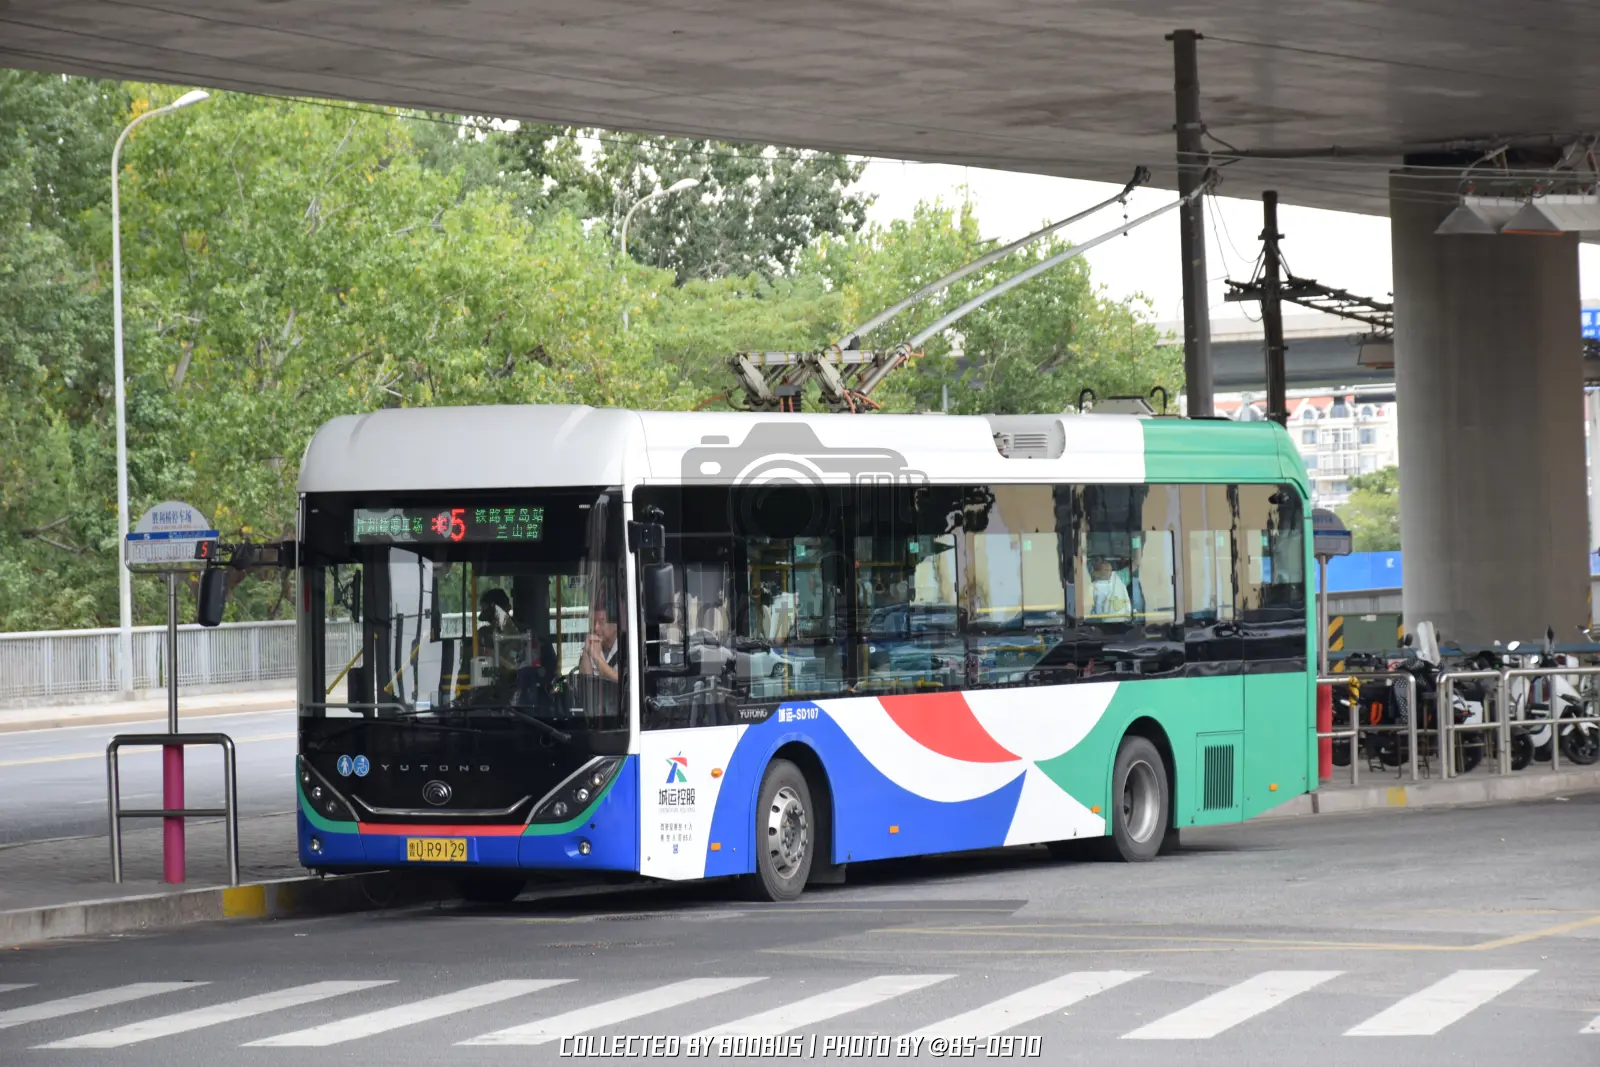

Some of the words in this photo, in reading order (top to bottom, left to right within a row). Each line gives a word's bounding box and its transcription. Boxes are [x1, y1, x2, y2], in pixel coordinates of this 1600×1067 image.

[450, 508, 466, 542] 5
[200, 541, 209, 558] 5
[738, 708, 768, 719] YUTONG
[380, 763, 490, 773] YUTONG
[658, 788, 696, 806] 城运控股
